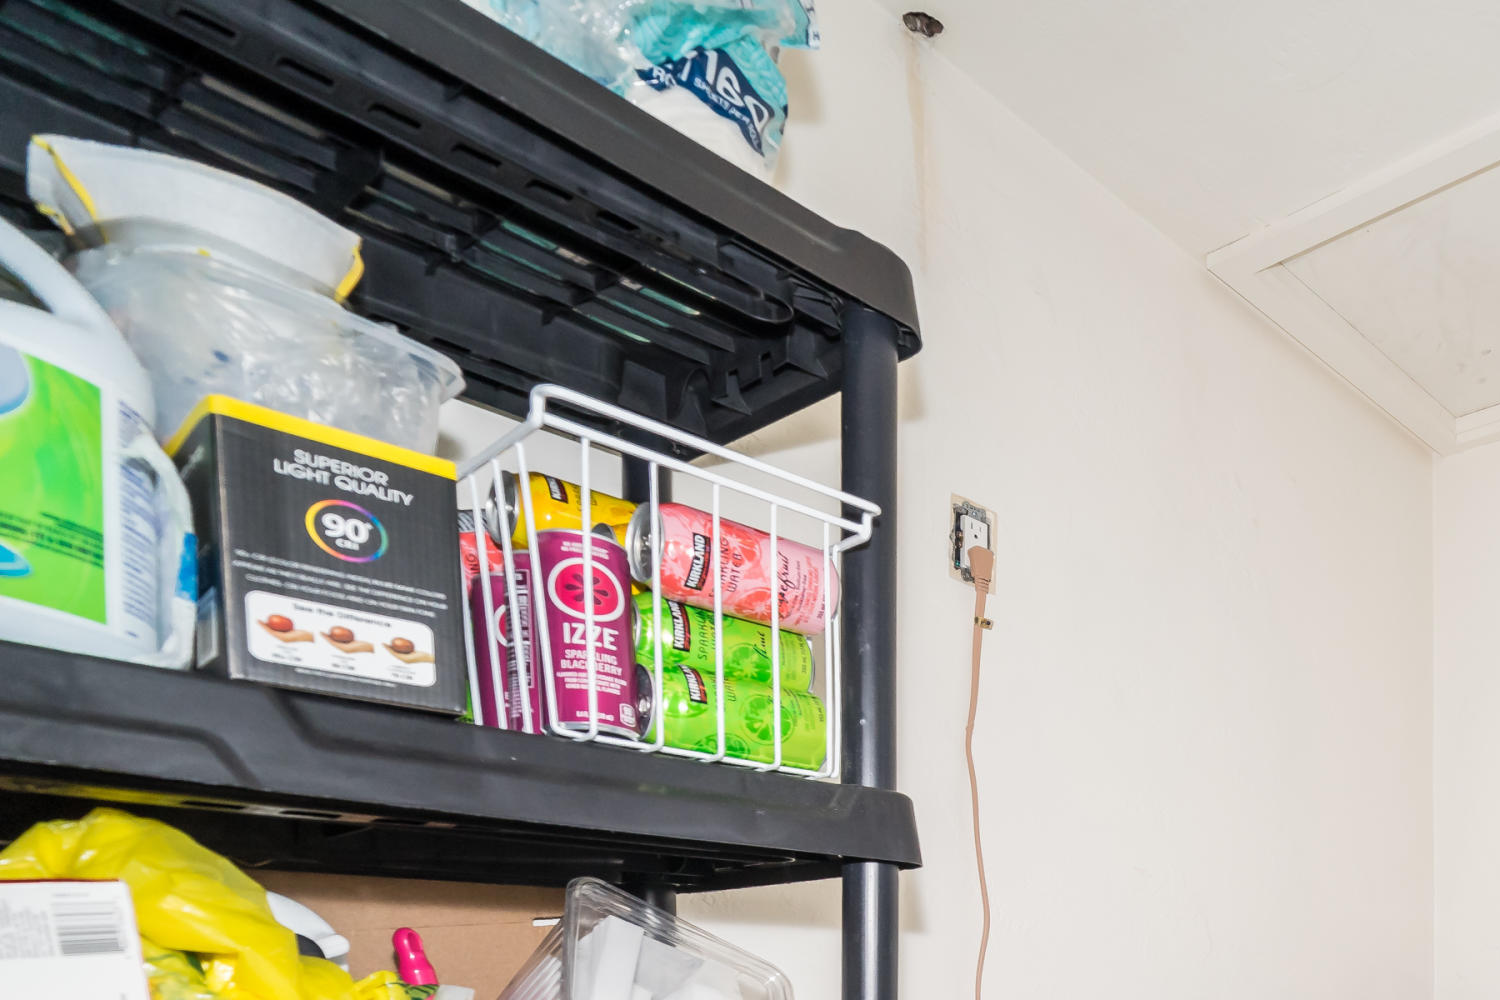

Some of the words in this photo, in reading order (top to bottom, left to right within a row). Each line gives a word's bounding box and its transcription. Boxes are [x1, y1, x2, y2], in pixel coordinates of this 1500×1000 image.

[273, 458, 331, 486] LIGHT
[334, 476, 415, 506] QUALITY
[293, 449, 389, 486] SUPERIOR
[686, 534, 707, 590] KIRKLAND
[726, 552, 743, 594] WATER
